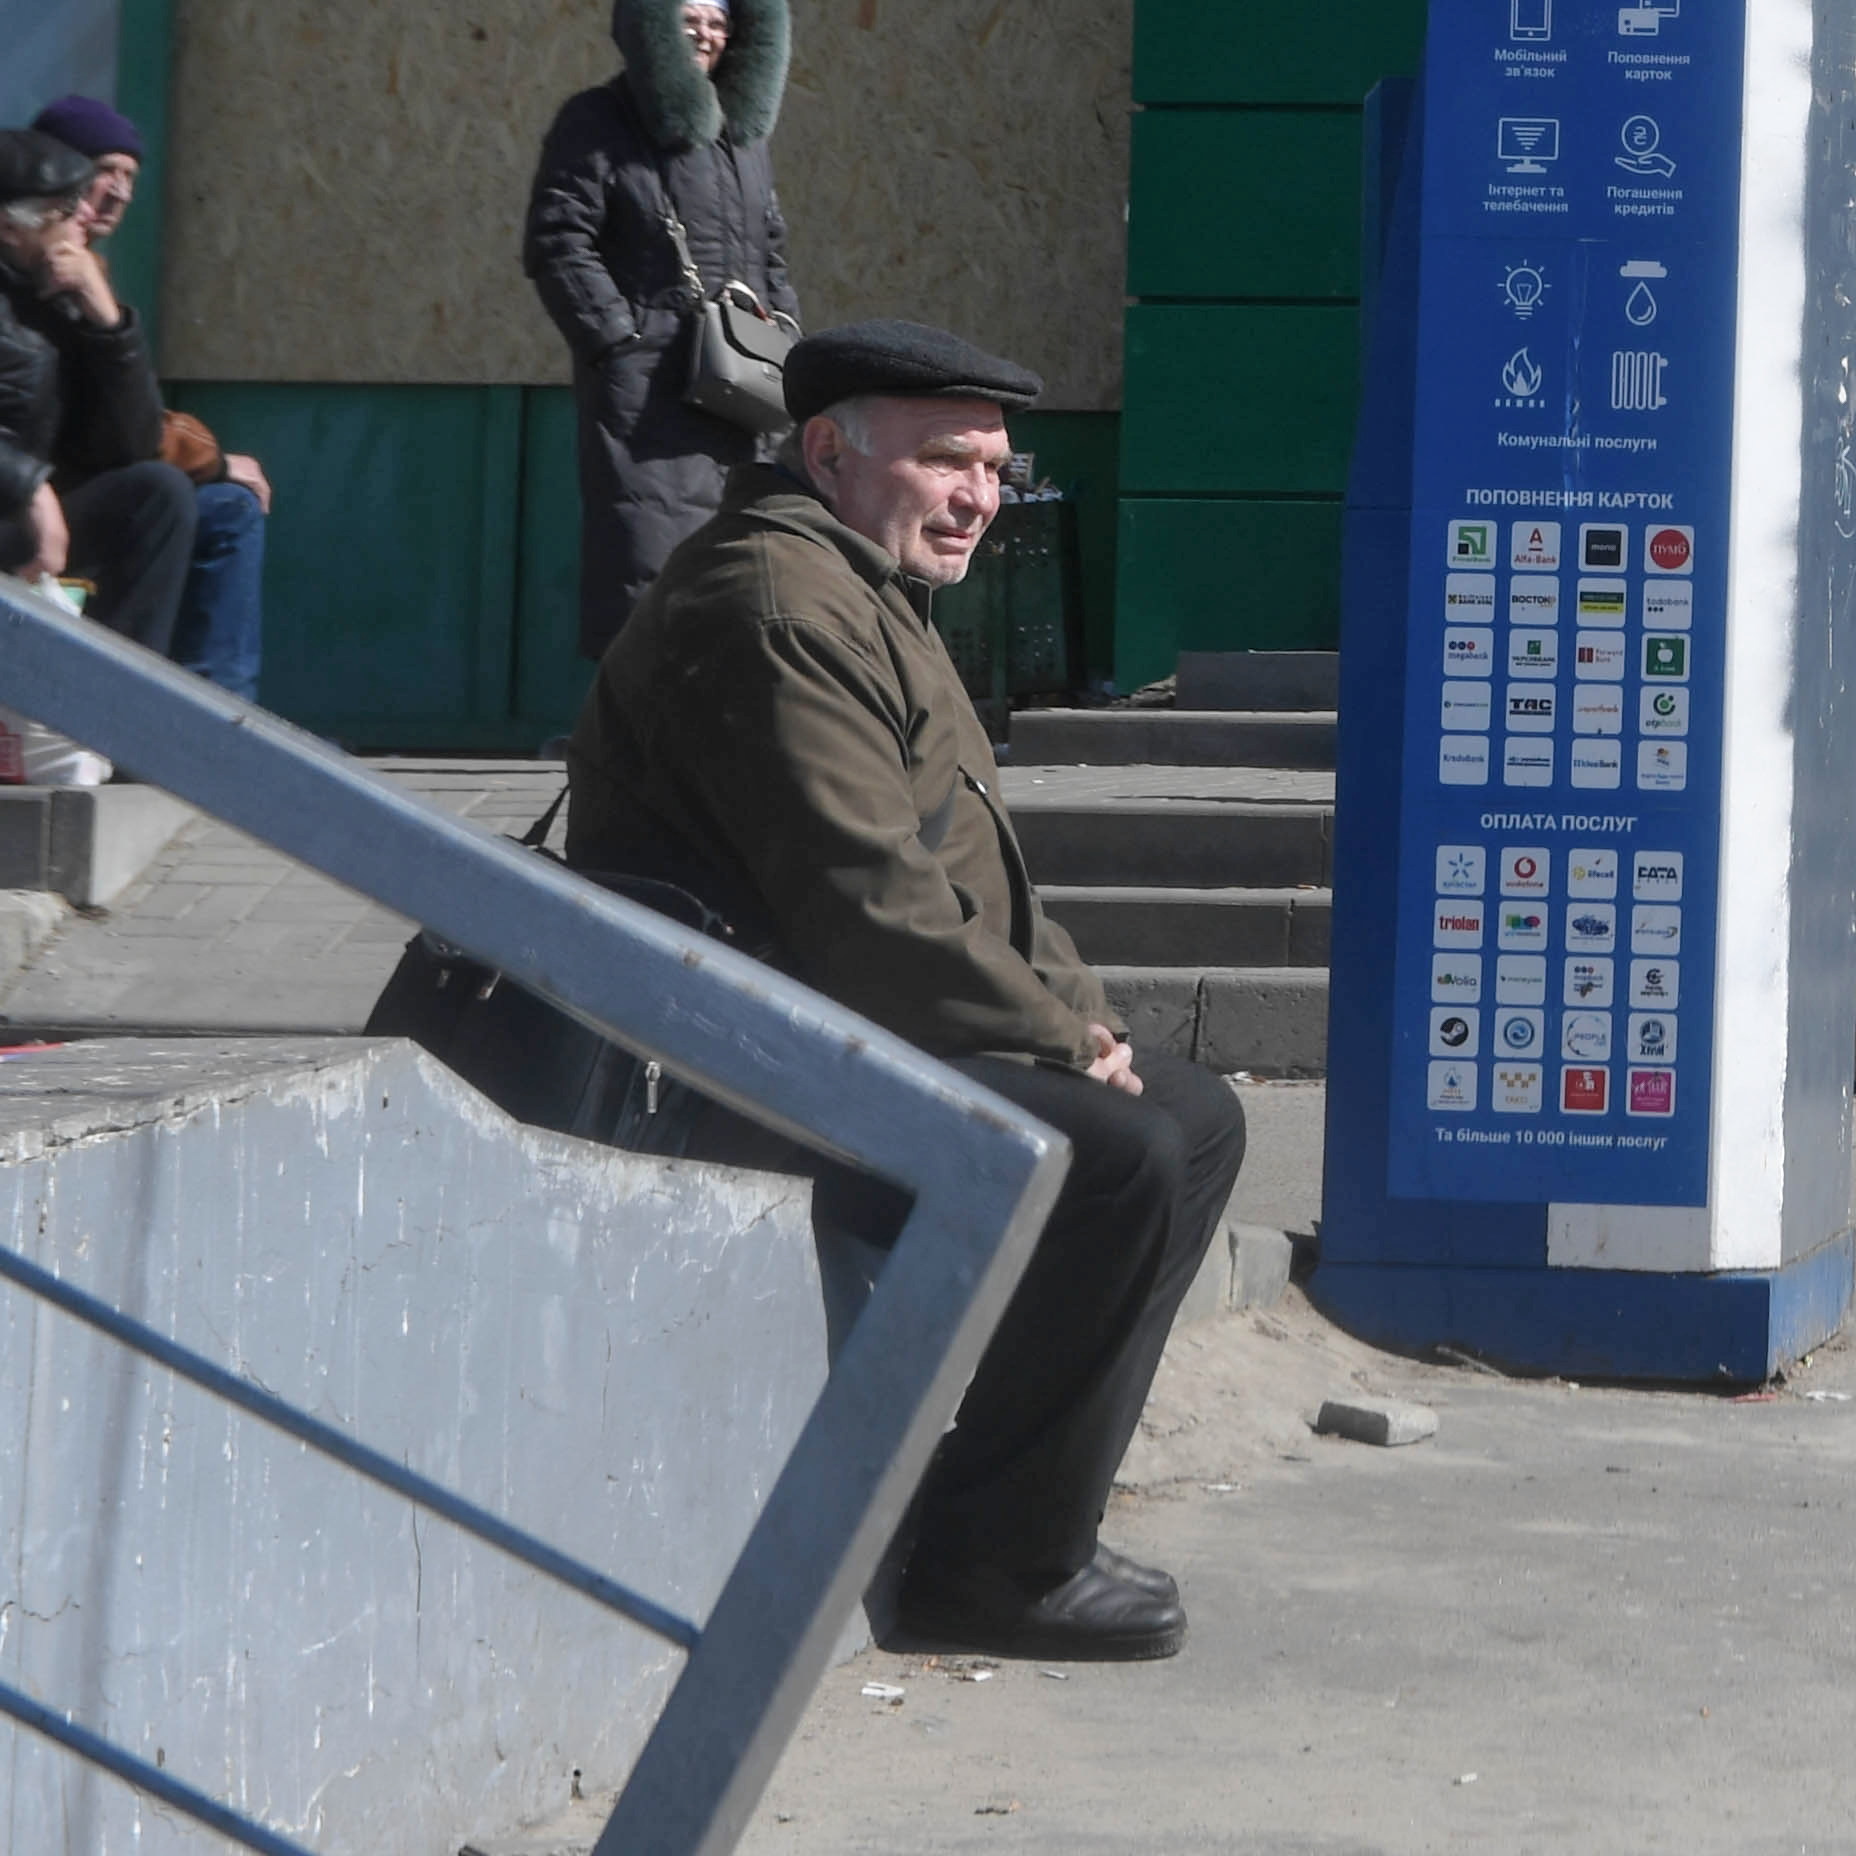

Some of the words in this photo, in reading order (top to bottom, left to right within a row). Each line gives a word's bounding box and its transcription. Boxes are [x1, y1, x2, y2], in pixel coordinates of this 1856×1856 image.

[1494, 48, 1568, 64] Мобільний
[1607, 51, 1690, 66] Поповнення
[1624, 68, 1673, 82] карток
[1487, 183, 1546, 199] Інтернет
[1548, 186, 1565, 199] та
[1606, 185, 1683, 201] Погашення
[1483, 199, 1569, 214] телебачення
[1614, 202, 1675, 217] кредитів
[1498, 431, 1590, 450] Комунальні
[1594, 435, 1657, 453] послуги
[1465, 488, 1594, 508] ПОПОВНЕННЯ
[1598, 491, 1674, 509] КАРТОК
[1480, 813, 1557, 831] ОПЛАТА
[1562, 814, 1638, 833] ПОСЛУГ
[1439, 914, 1480, 932] triolan
[1435, 1128, 1453, 1143] Та
[1456, 1128, 1511, 1144] більше
[1515, 1130, 1533, 1145] 10
[1536, 1130, 1565, 1146] 000
[1569, 1132, 1614, 1148] інших
[1616, 1135, 1667, 1151] послуг
